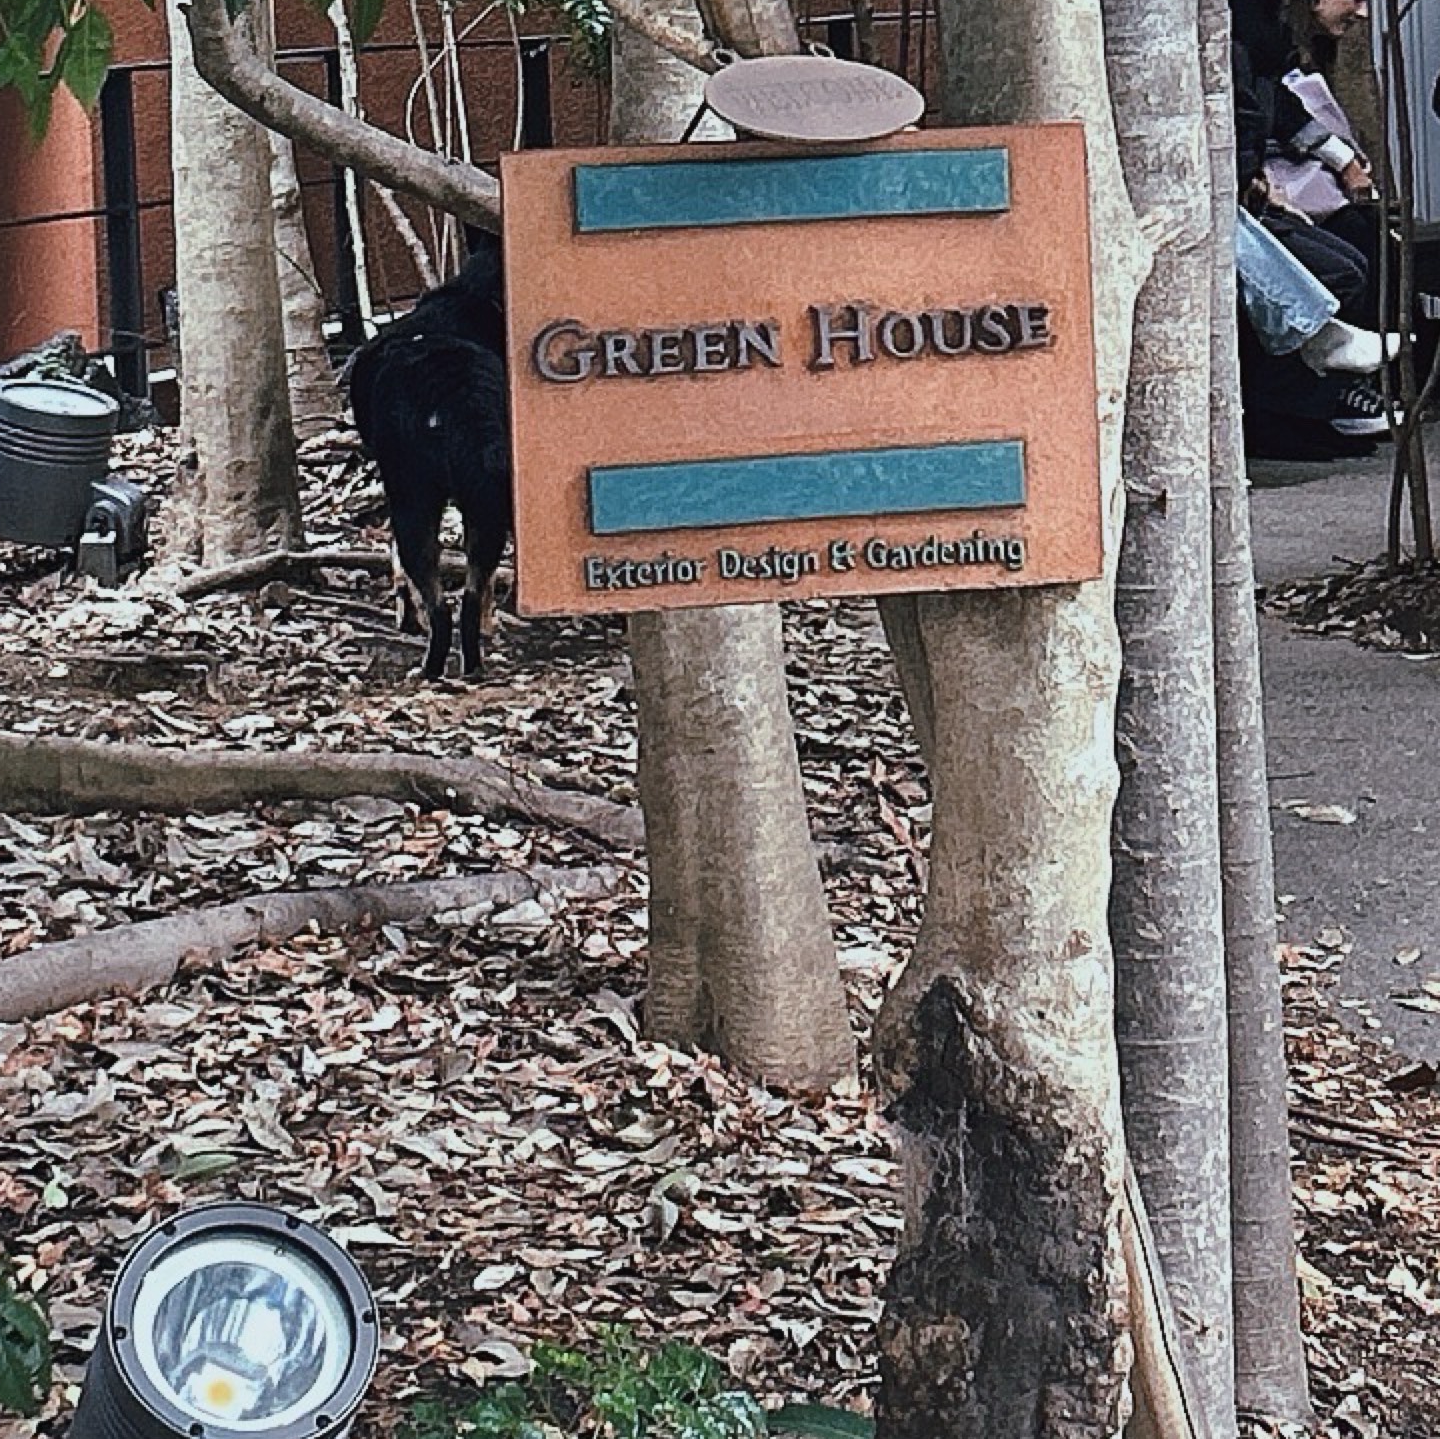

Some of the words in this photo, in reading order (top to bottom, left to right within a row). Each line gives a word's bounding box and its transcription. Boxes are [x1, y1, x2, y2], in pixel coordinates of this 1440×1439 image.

[534, 317, 783, 383] GREEN
[808, 301, 1054, 370] HOUSE
[586, 555, 706, 589] Exterior
[719, 543, 820, 582] Design
[830, 539, 857, 572] &
[866, 529, 1026, 570] Gardening
